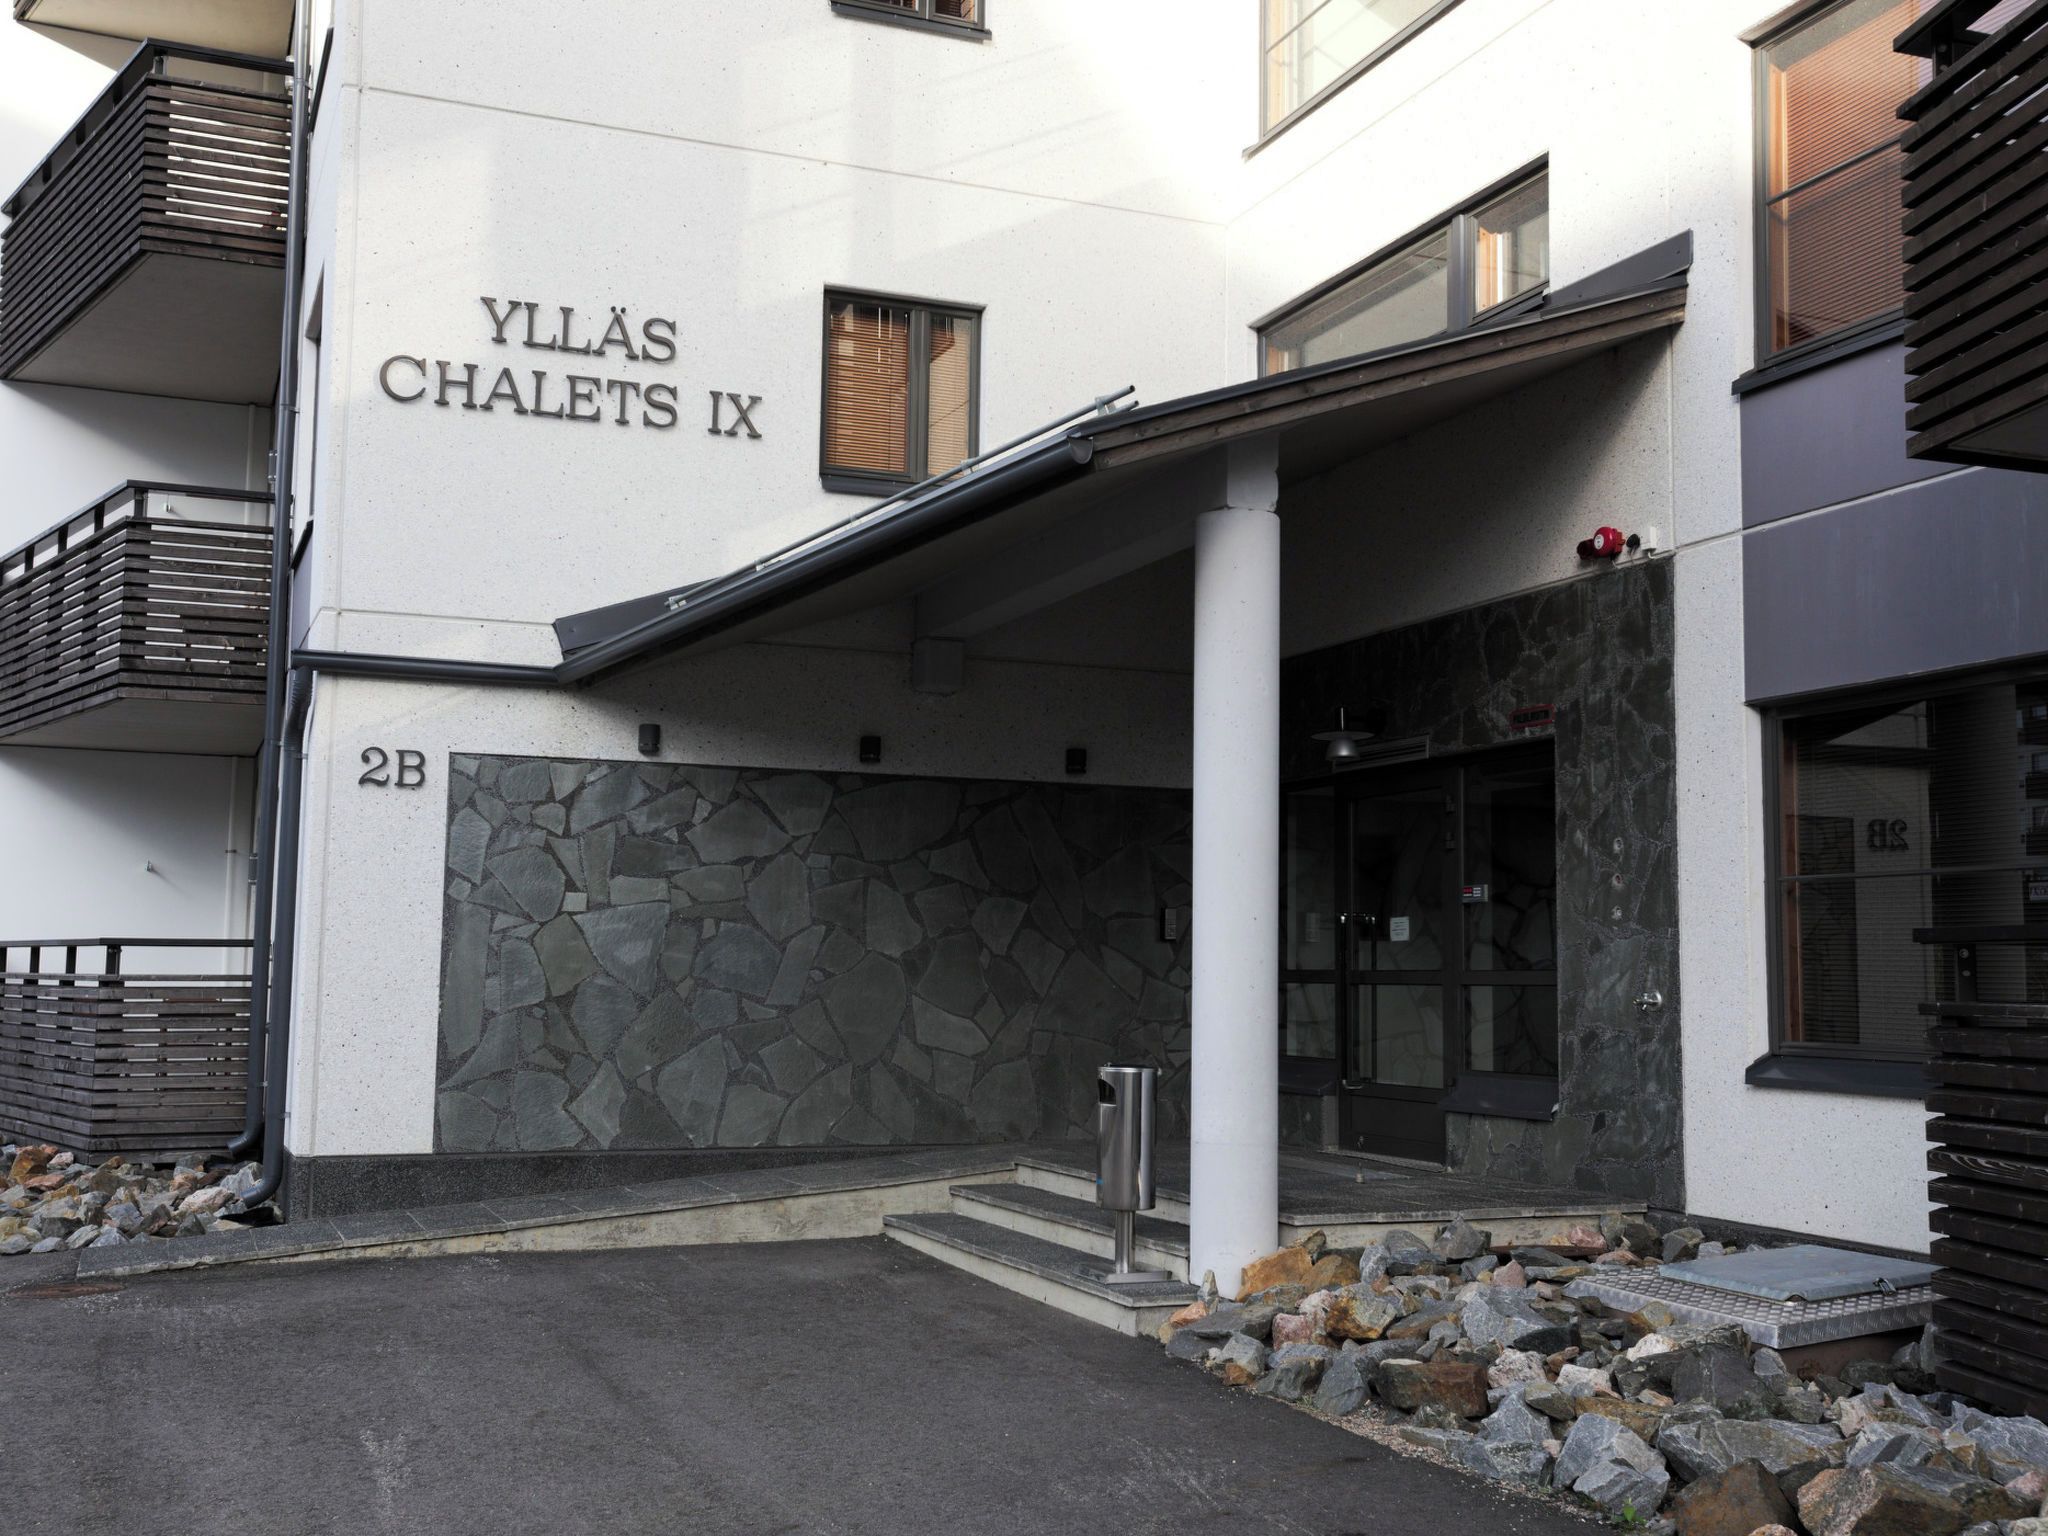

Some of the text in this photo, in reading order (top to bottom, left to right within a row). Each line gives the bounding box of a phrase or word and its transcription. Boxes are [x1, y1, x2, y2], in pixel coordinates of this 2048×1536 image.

[479, 295, 677, 365] YLLÄS
[378, 354, 763, 440] CHALETS IX
[358, 746, 426, 787] 2B
